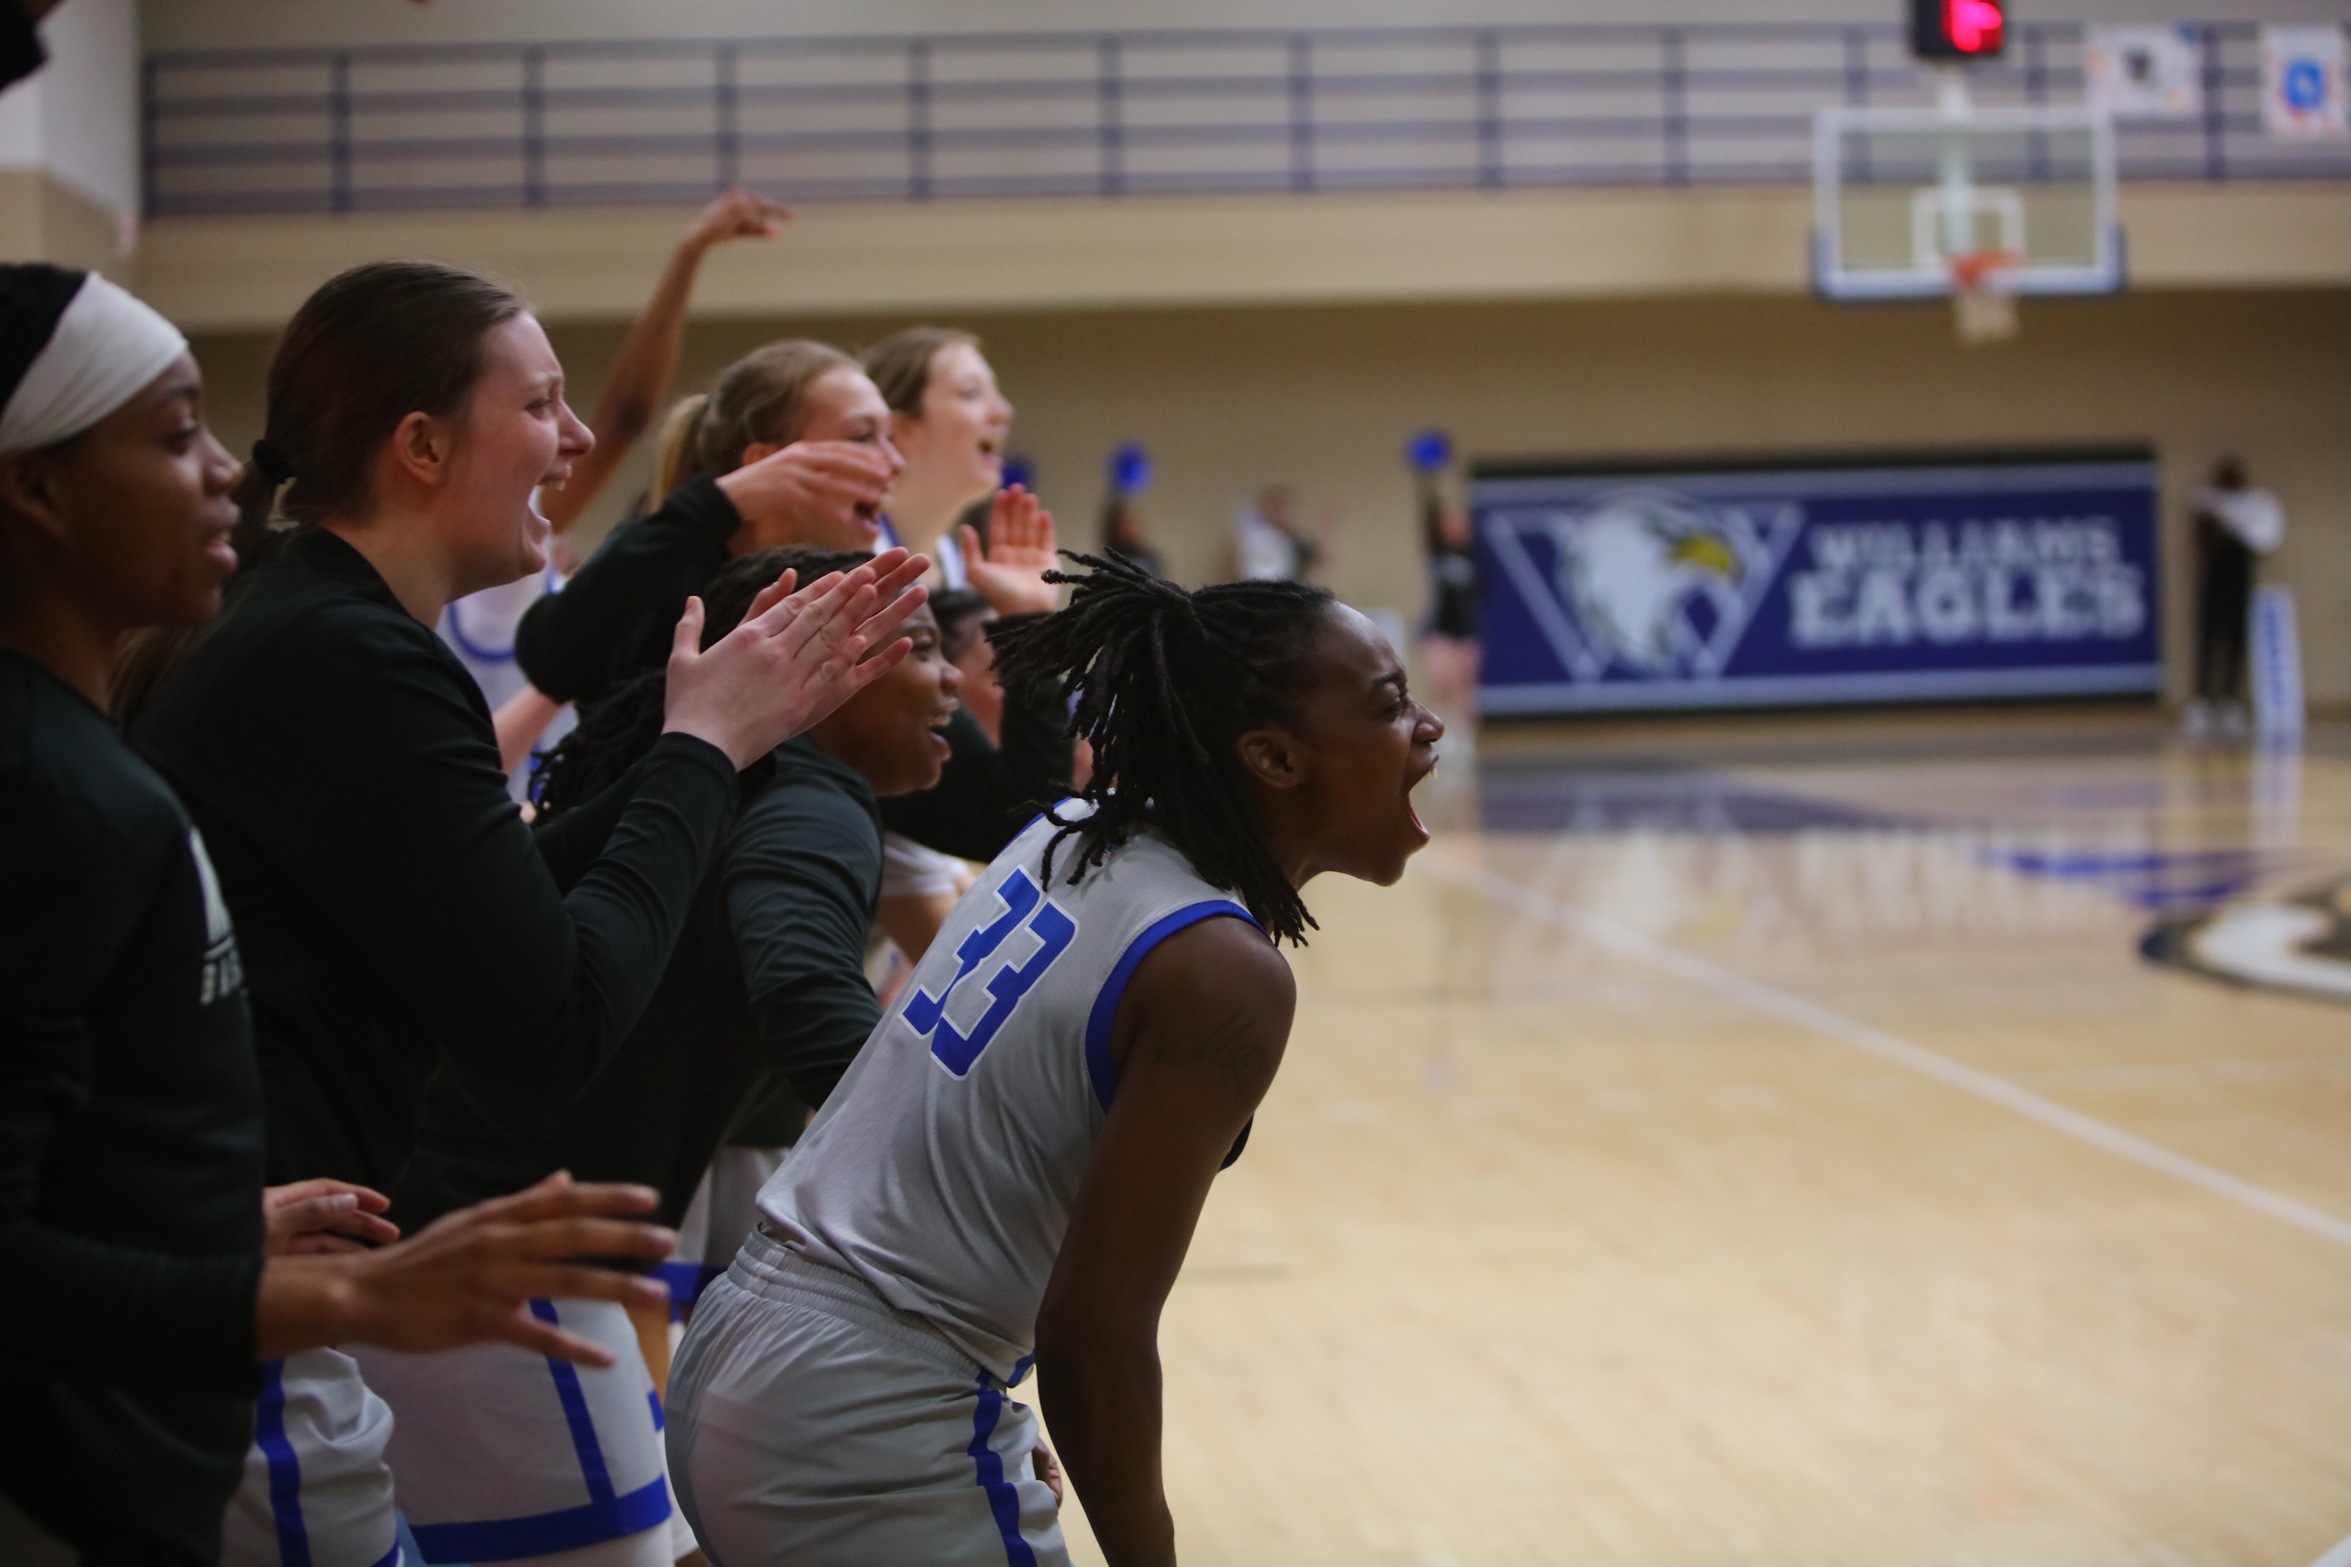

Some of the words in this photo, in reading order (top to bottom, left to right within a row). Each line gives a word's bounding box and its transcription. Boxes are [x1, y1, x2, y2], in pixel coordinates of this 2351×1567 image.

[1810, 518, 2118, 569] WILLIAMS
[1790, 563, 2145, 645] EAGLES
[898, 864, 1079, 1080] 33
